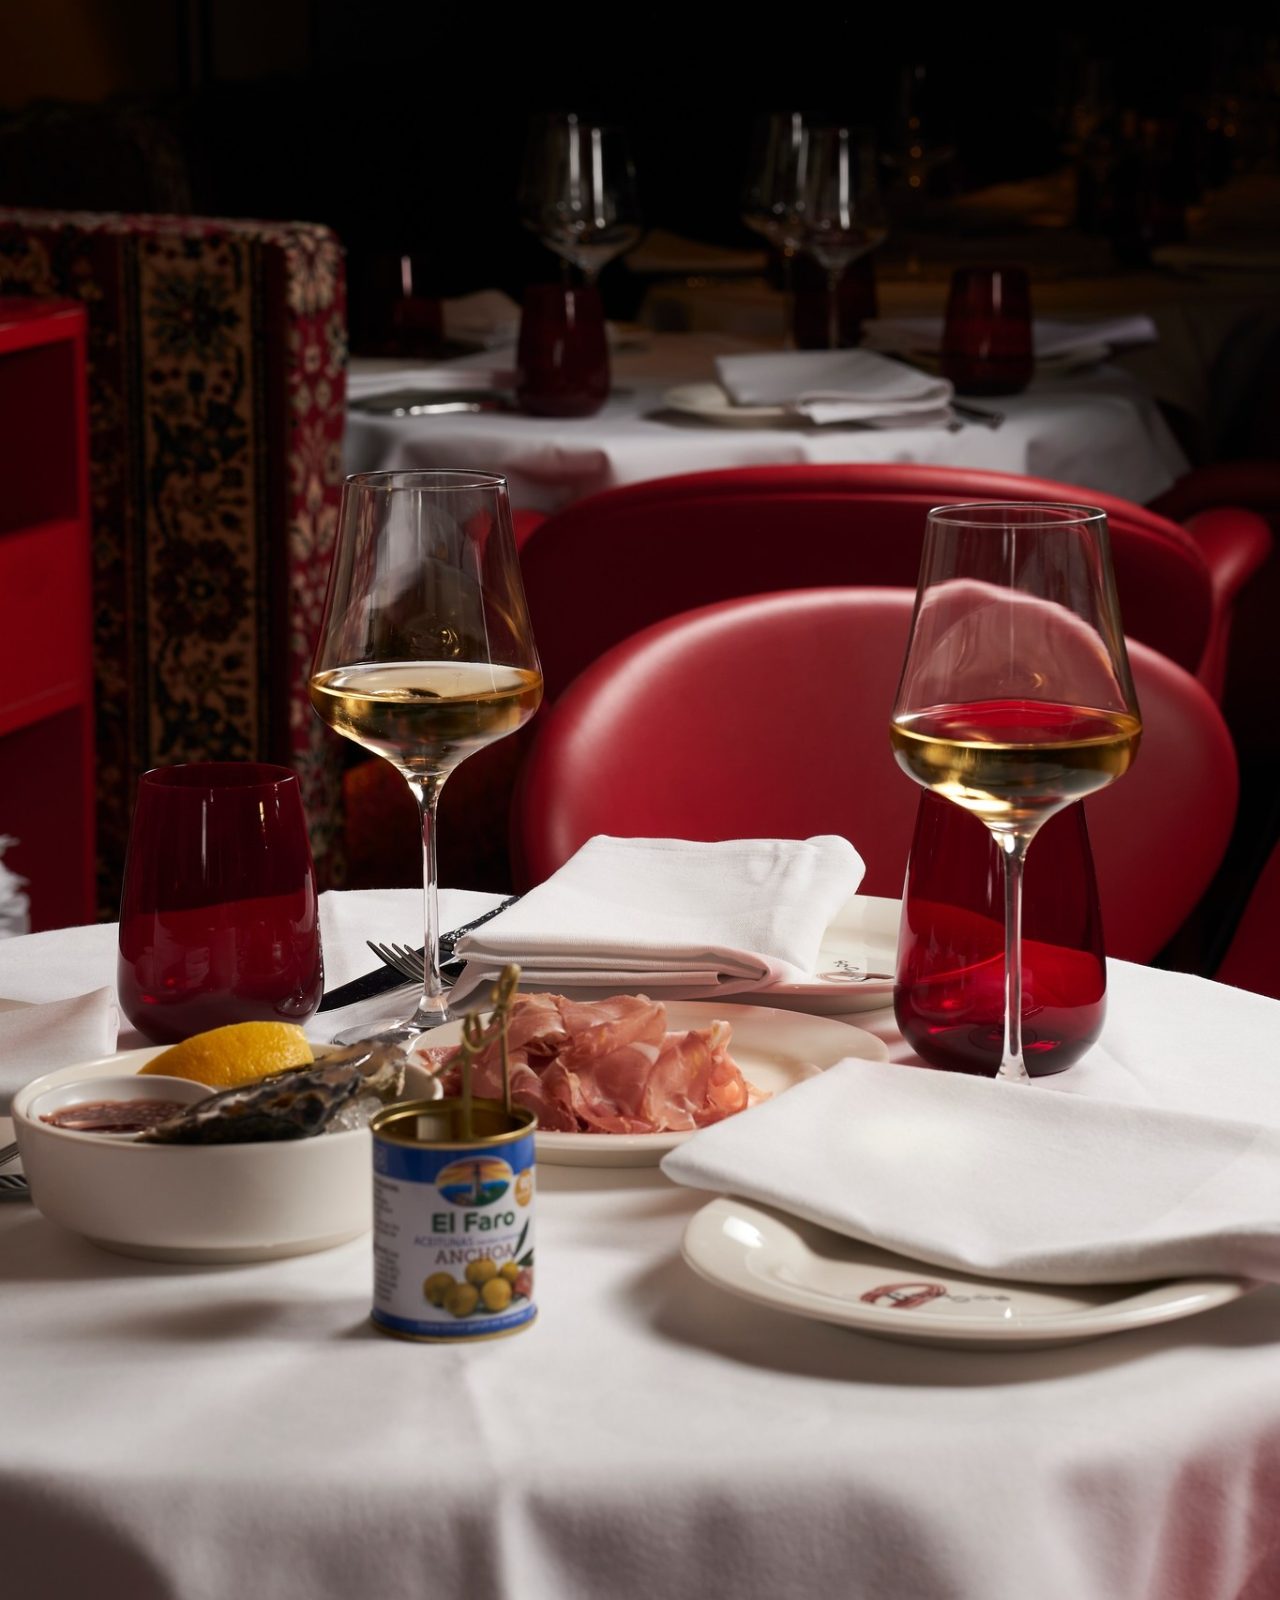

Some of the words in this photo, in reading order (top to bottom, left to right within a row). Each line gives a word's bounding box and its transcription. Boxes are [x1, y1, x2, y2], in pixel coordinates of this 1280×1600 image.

[432, 1212, 455, 1233] El
[464, 1211, 515, 1232] Faro
[413, 1235, 473, 1247] ACEITUNAS
[434, 1244, 514, 1265] ANCHOA
